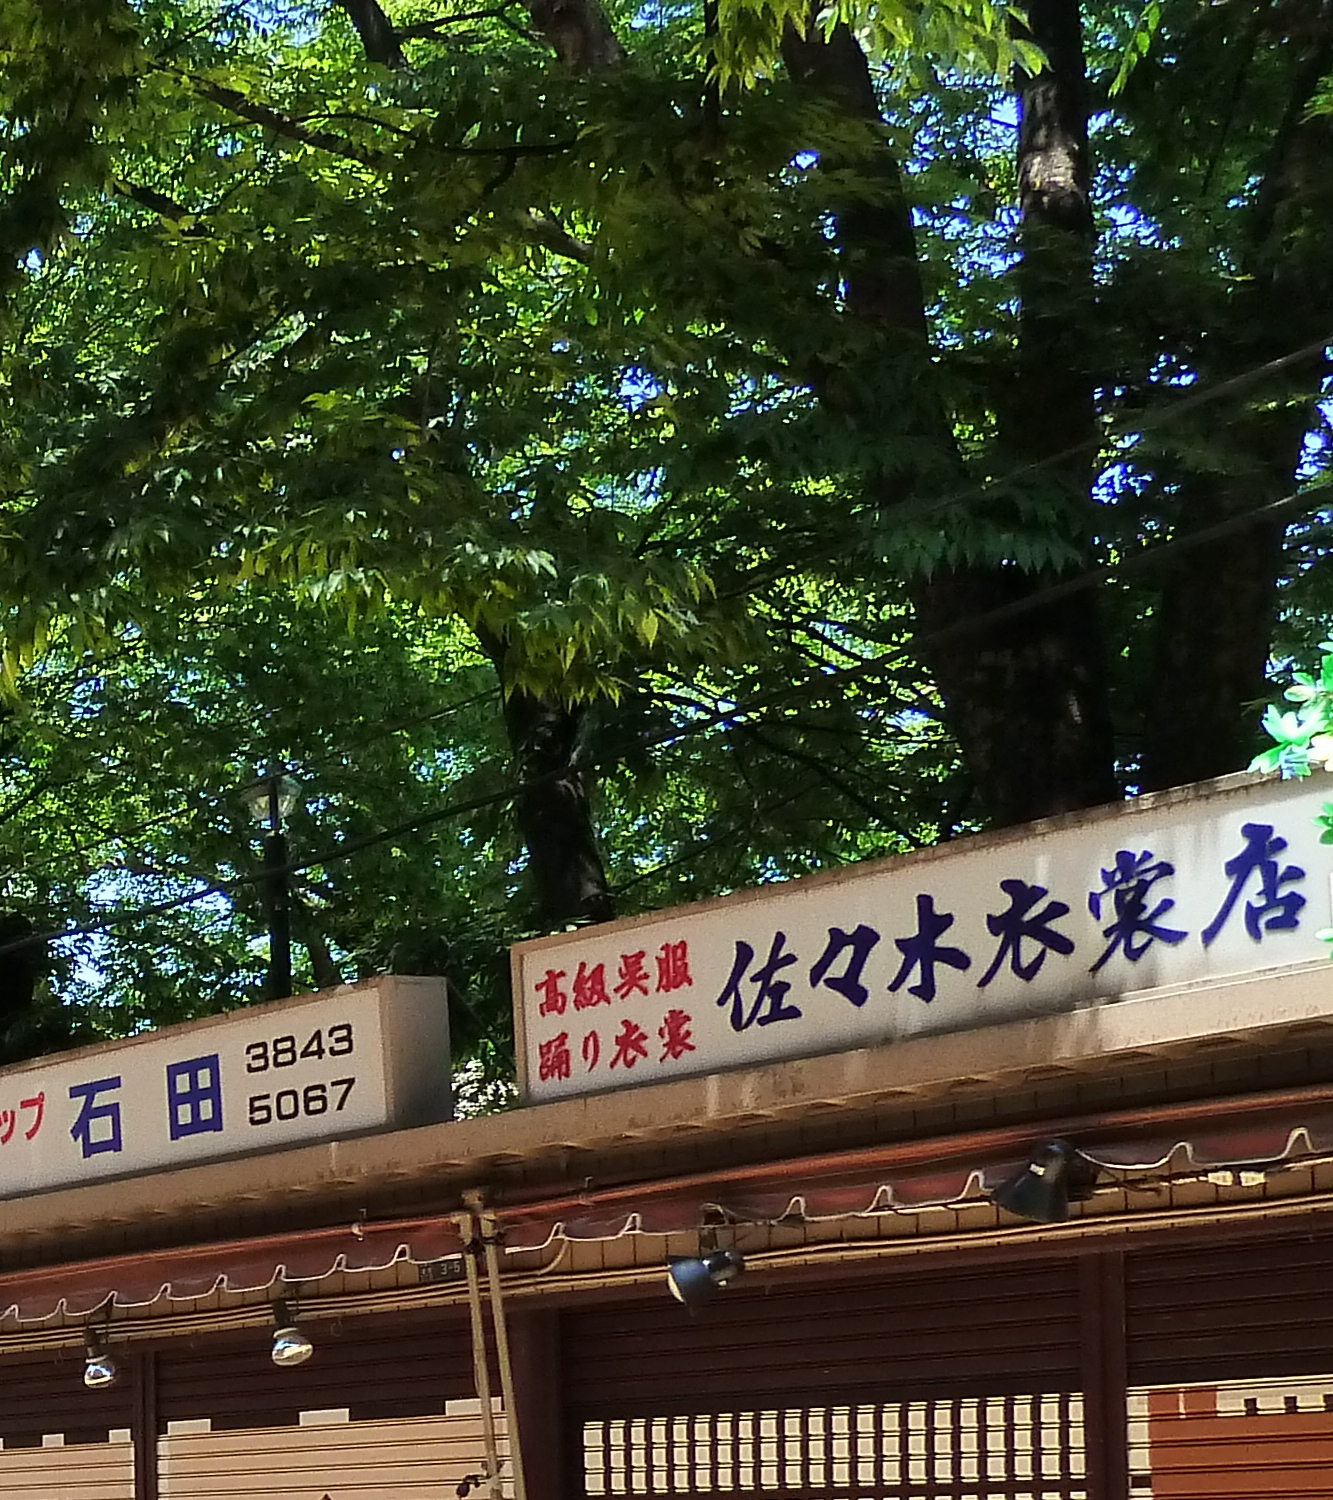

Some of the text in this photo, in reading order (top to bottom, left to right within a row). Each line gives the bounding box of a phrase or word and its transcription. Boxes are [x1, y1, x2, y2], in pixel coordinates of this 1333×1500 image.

[716, 822, 1309, 1033] 佐々木衣裳店
[534, 939, 694, 1020] 高級呉服
[244, 1022, 355, 1075] 3843
[537, 1009, 696, 1083] 踊り衣裳
[68, 1053, 224, 1159] 石田
[247, 1077, 356, 1126] 5067
